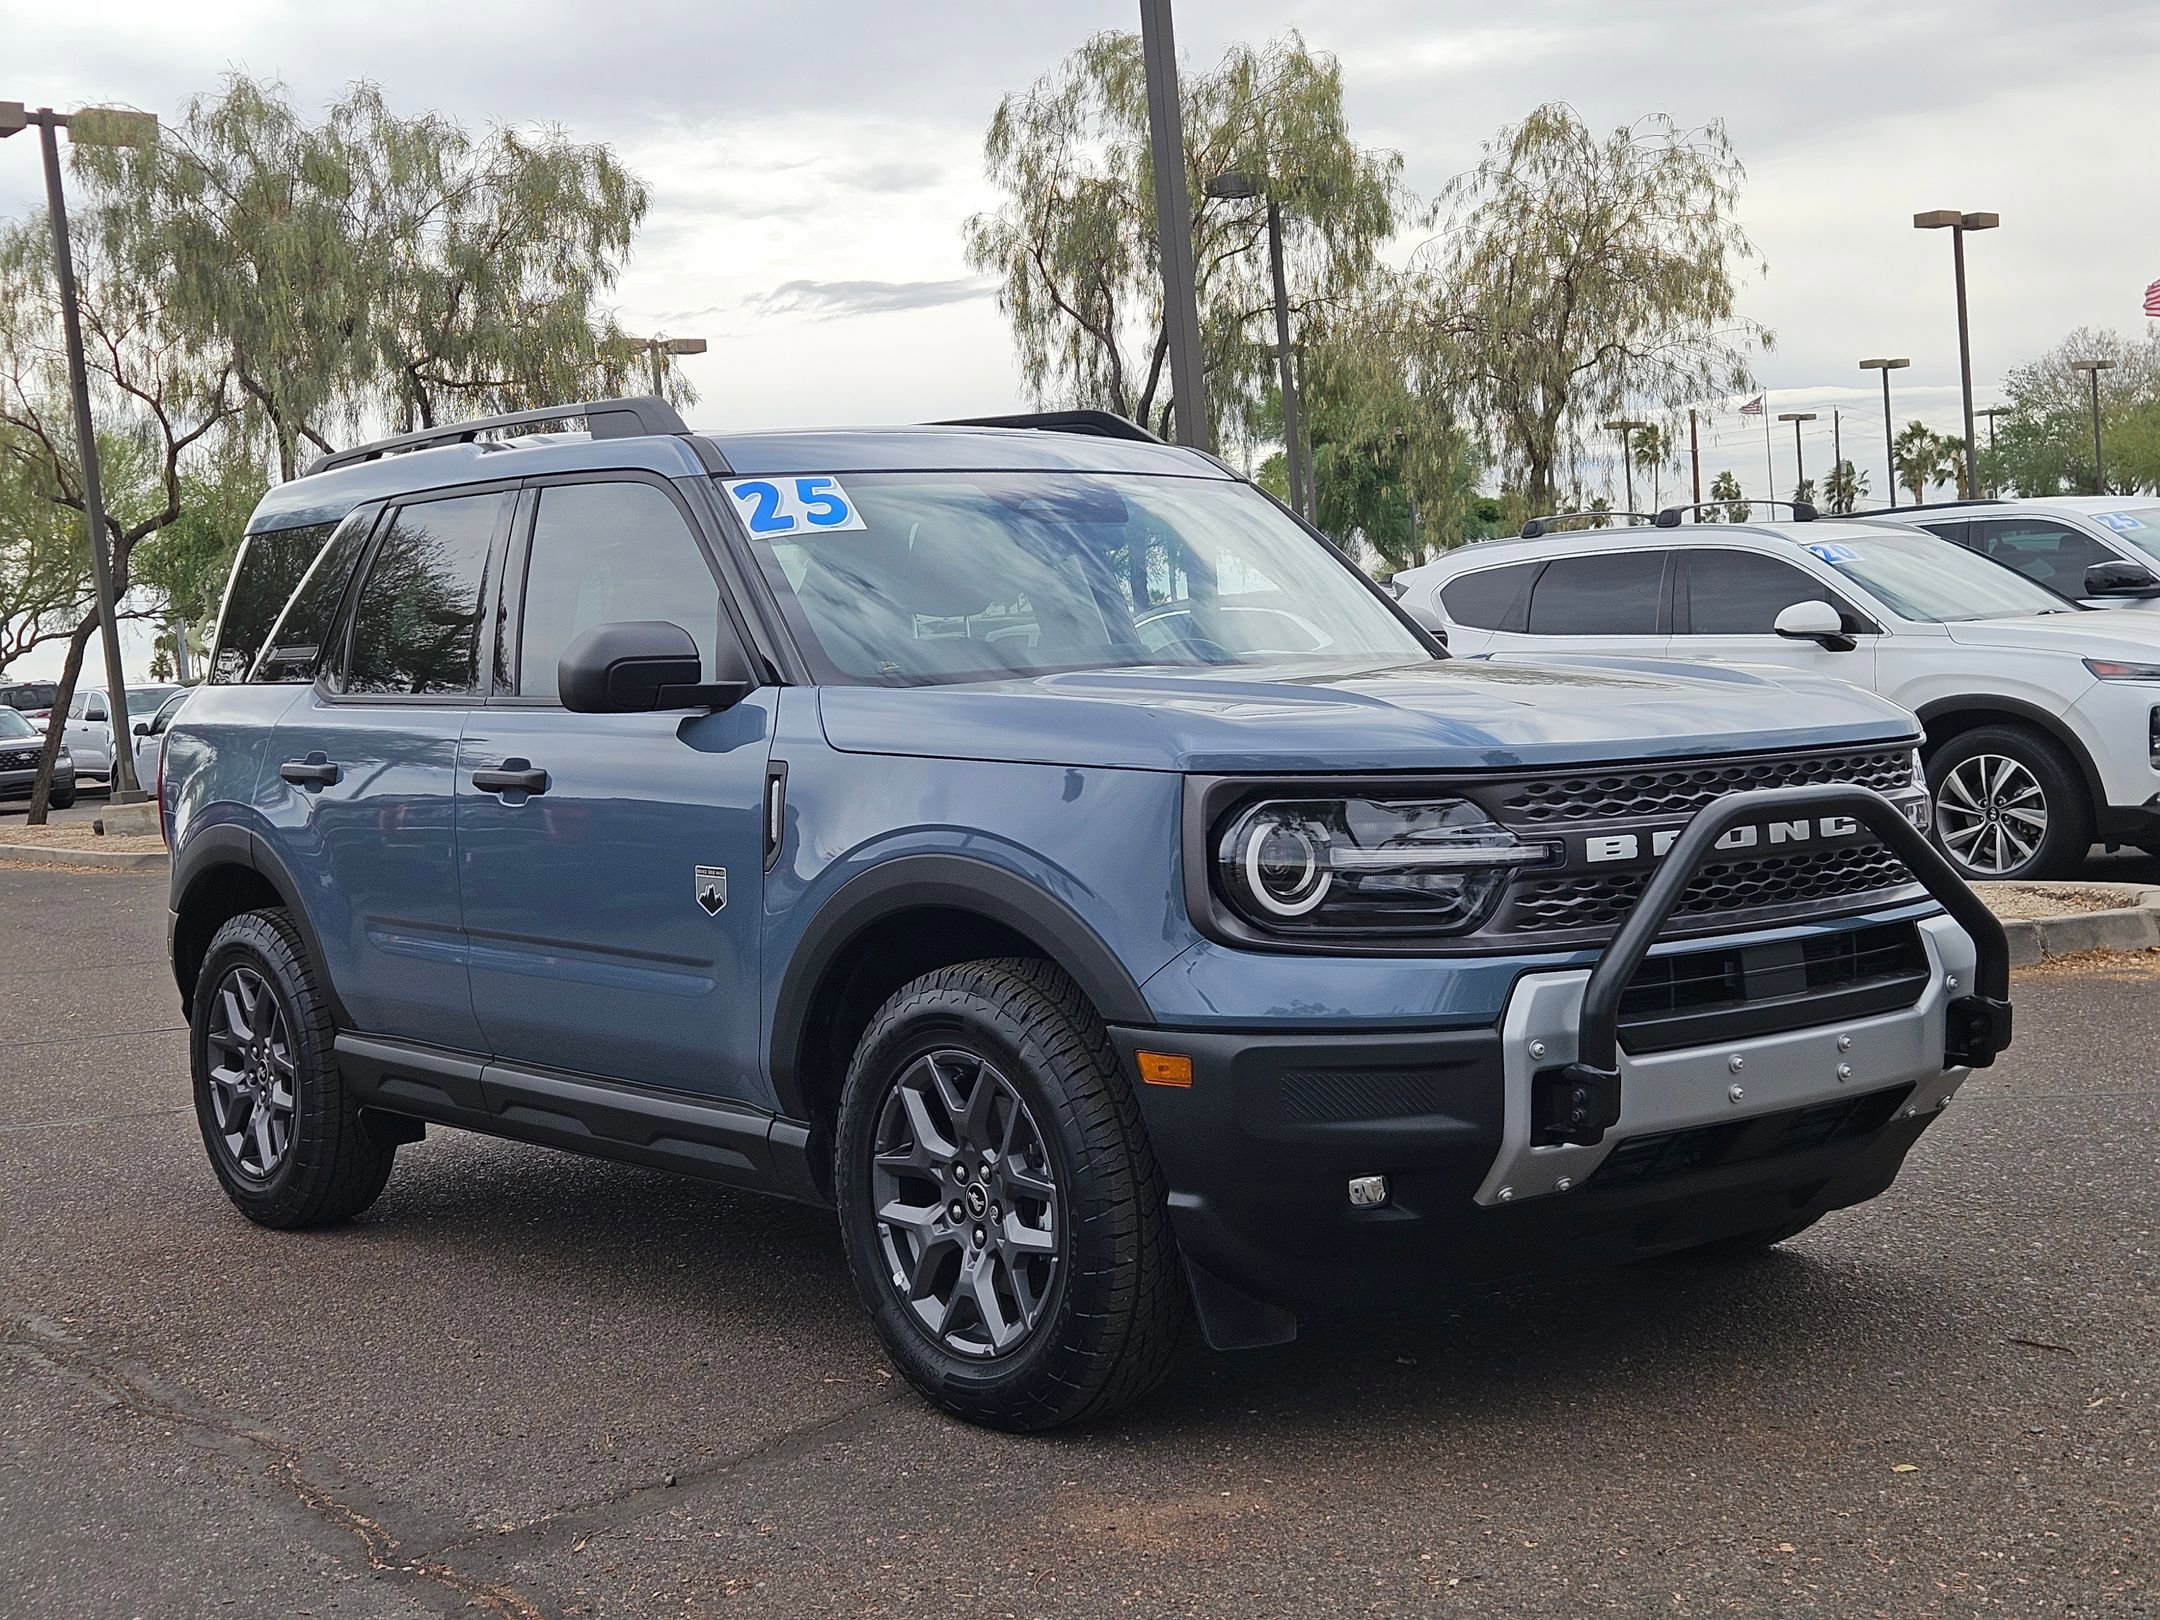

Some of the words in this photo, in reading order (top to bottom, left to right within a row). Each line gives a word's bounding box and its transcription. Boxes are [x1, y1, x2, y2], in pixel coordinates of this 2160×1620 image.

[732, 478, 849, 533] 25
[2096, 512, 2139, 530] 25
[1809, 543, 1857, 562] 20
